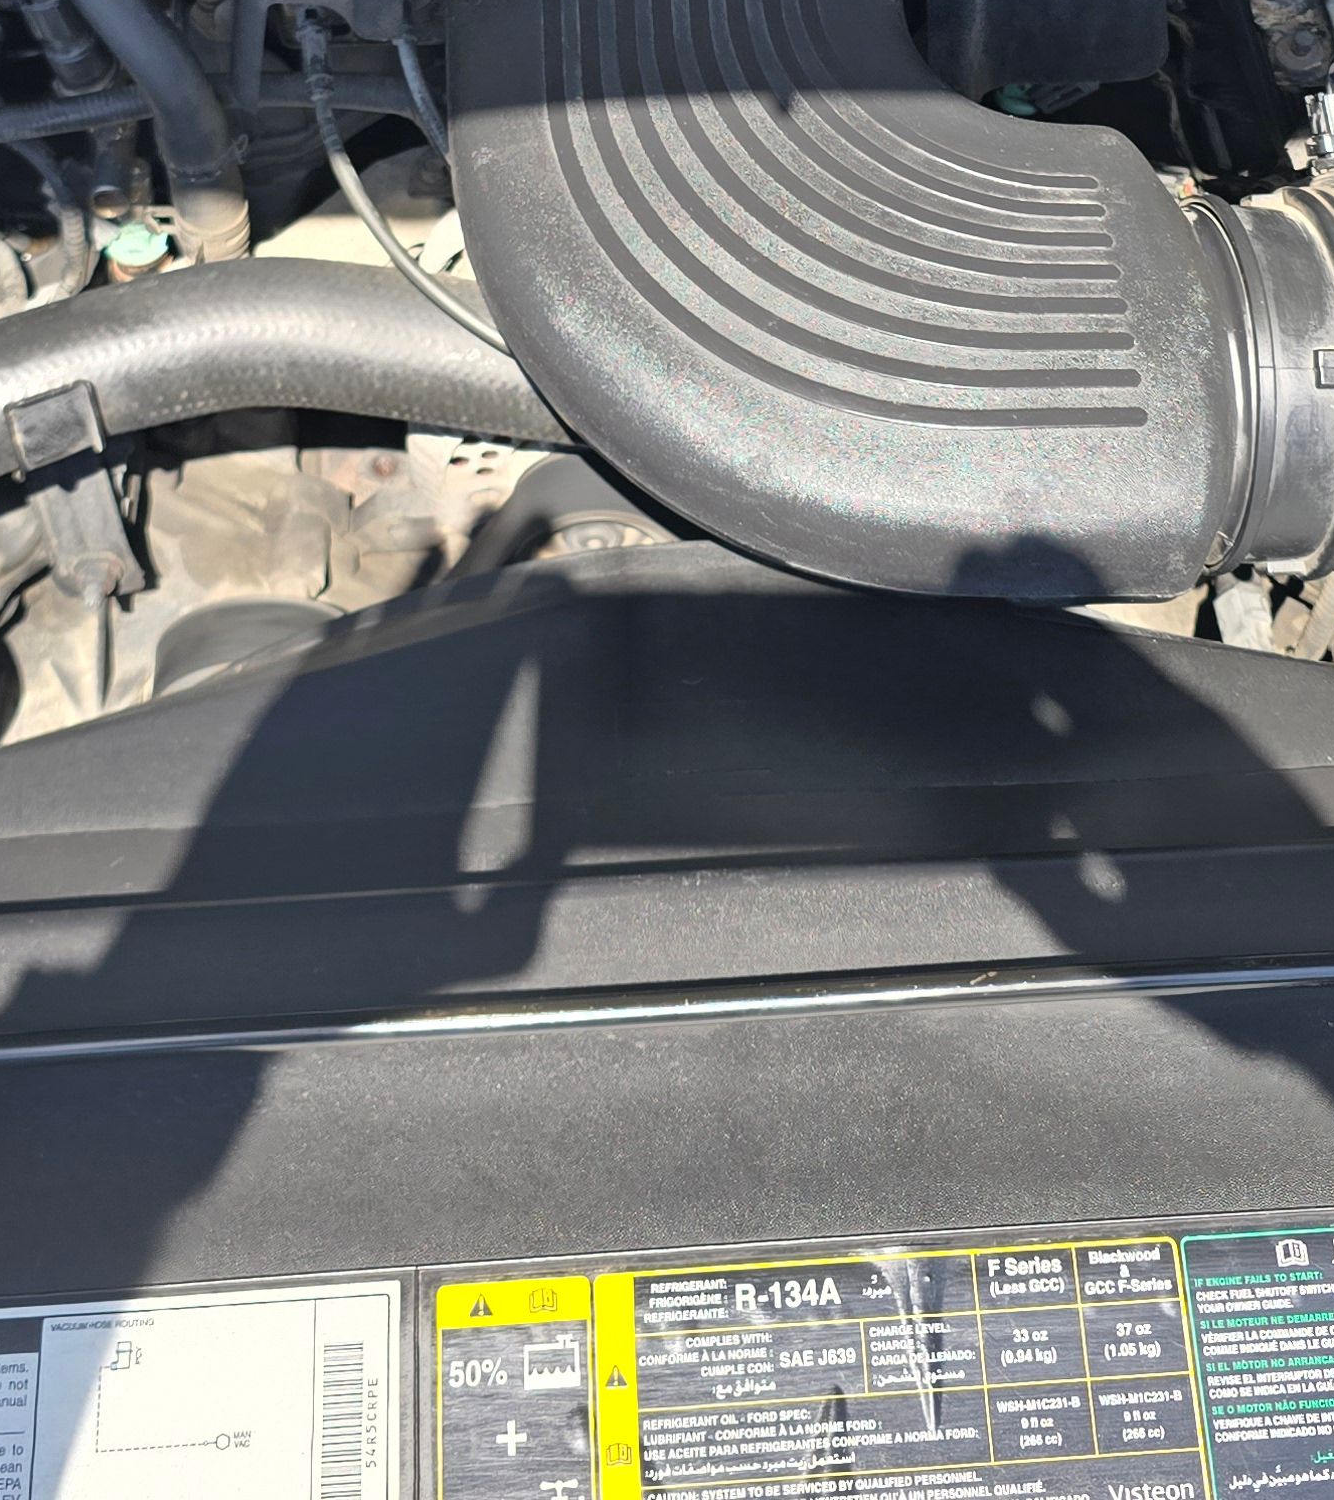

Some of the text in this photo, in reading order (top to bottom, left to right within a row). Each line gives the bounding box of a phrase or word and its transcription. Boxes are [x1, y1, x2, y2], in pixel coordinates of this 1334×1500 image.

[1088, 1246, 1161, 1265] Blackwood
[988, 1256, 1063, 1277] F Series
[650, 1278, 727, 1294] REFRIGERANT:
[989, 1276, 1065, 1298] (Less GCC)
[1084, 1278, 1173, 1296] GCC F-Series
[1194, 1271, 1323, 1288] IF ENGINE FAILS TO START:
[735, 1277, 842, 1311] R-134A
[643, 1307, 729, 1323] REFRIGERANTE:
[868, 1323, 951, 1337] CHARGE LEVEL:
[1012, 1329, 1049, 1343] 33 oz
[1116, 1323, 1152, 1337] 37 oz
[685, 1332, 773, 1348] COMPLIES WITH:
[870, 1338, 915, 1351] CHARGE
[638, 1352, 699, 1366] CONFORME
[712, 1350, 726, 1362] LA
[728, 1347, 768, 1360] NORME
[779, 1347, 857, 1368] SAE J639
[1000, 1346, 1058, 1367] (0.94 kg)
[1104, 1340, 1162, 1361] (1.05 kg)
[448, 1357, 508, 1388] 50%
[701, 1361, 774, 1377] CUMPLE CON:
[8, 1379, 29, 1390] not
[365, 1377, 379, 1469] 54R5CRPE
[642, 1408, 812, 1431] REFRIGERANT OIL FORD SPEC:
[12, 1444, 24, 1456] to
[234, 1440, 251, 1448] VAC
[646, 1471, 983, 1500] CAUTION: SYSTEM TO BE SERVICED BY QUALIFIED PERSONNEL.
[1108, 1482, 1194, 1500] Visteon
